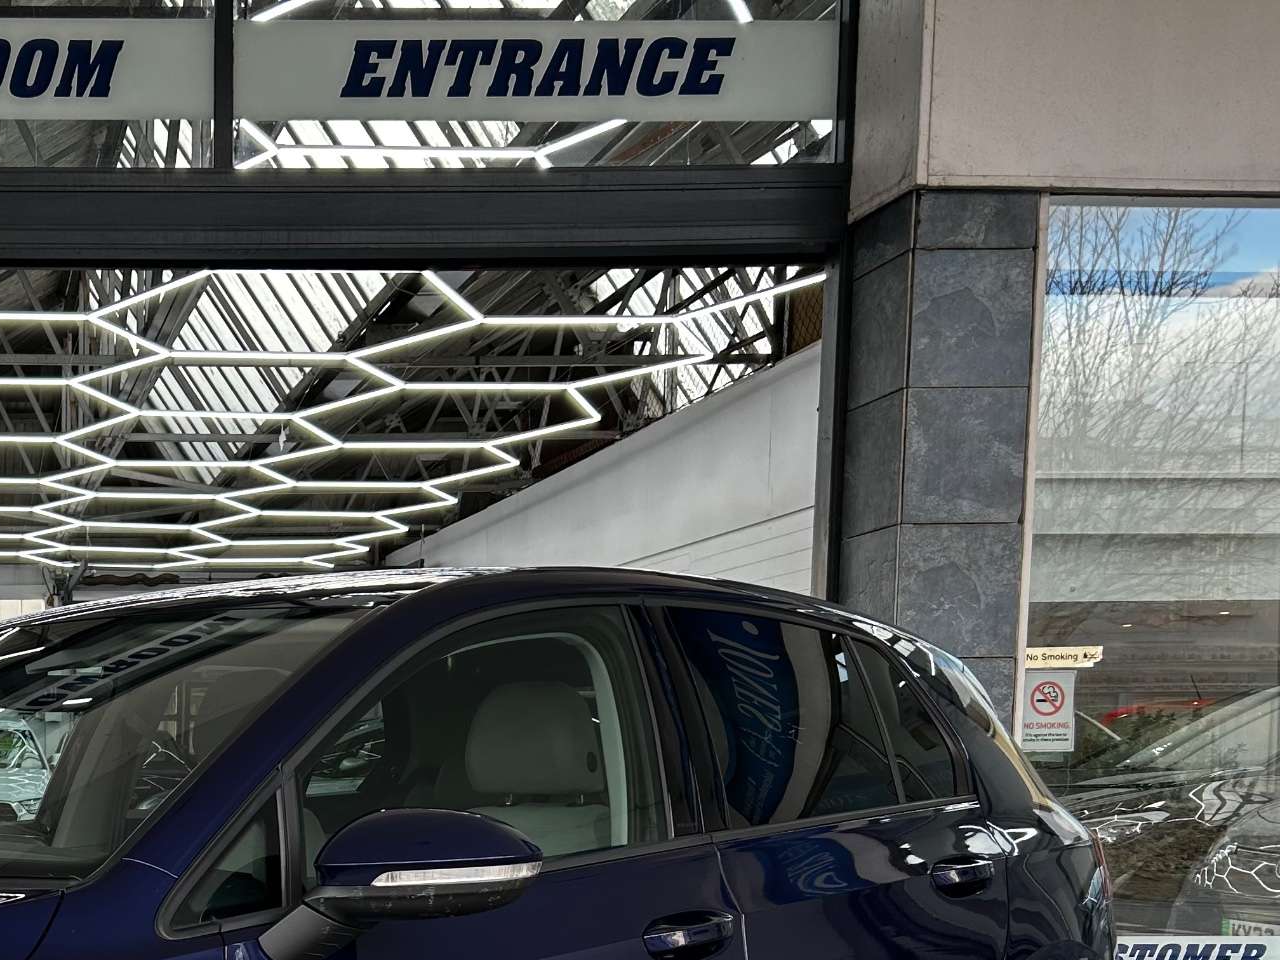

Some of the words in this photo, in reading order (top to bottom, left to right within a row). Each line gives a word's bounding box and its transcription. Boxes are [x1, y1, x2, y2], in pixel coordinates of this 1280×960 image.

[339, 36, 737, 98] ENTRANCE
[1026, 653, 1039, 661] No
[1041, 652, 1079, 663] Smoking
[1023, 721, 1034, 730] NO
